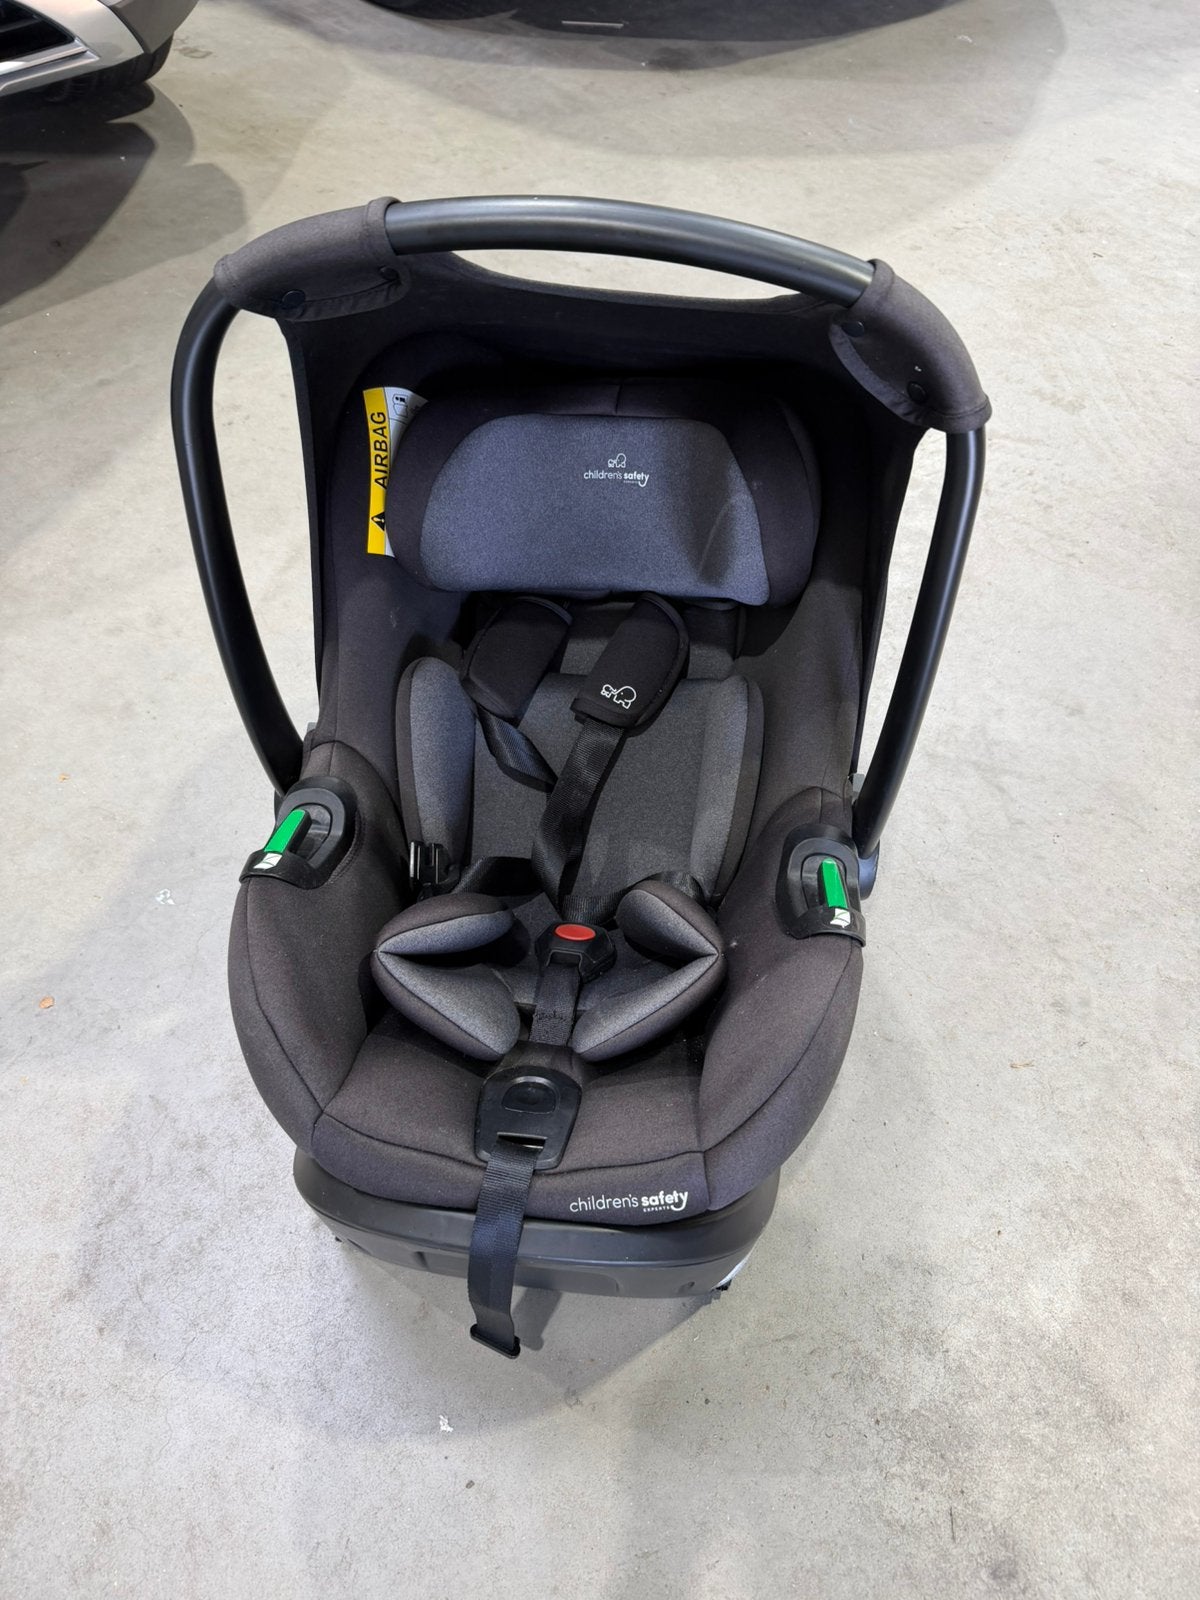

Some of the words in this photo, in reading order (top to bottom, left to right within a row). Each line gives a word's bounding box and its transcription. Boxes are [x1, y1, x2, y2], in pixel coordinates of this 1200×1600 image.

[370, 411, 389, 489] AIRBAG
[583, 470, 622, 480] children's
[623, 471, 650, 487] safety
[569, 1194, 639, 1212] children's
[641, 1190, 688, 1211] safety
